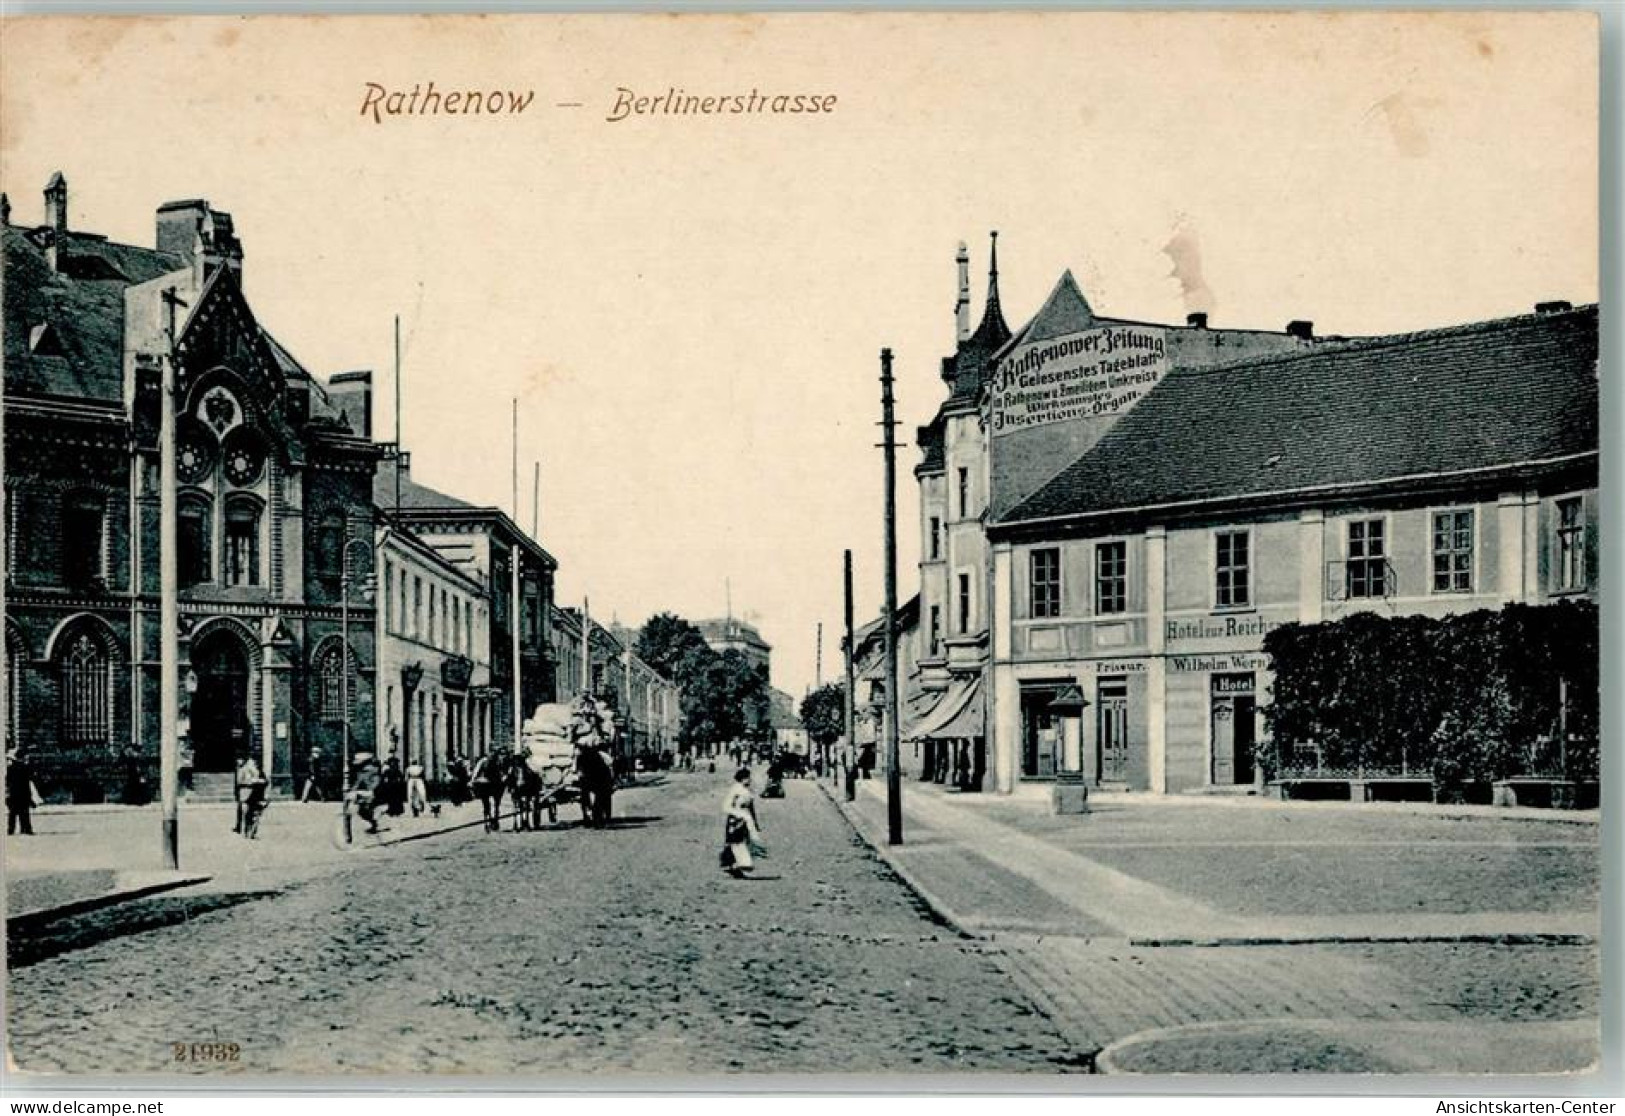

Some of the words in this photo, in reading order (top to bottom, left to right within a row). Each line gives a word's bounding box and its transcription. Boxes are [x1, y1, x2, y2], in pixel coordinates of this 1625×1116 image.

[996, 333, 1101, 392] Rathenower
[1101, 328, 1165, 358] Zeitung
[1019, 364, 1098, 388] Gelesenstes
[1167, 618, 1204, 639] Hotel
[1173, 657, 1228, 672] Wilhelm
[1220, 677, 1253, 691] Hotel
